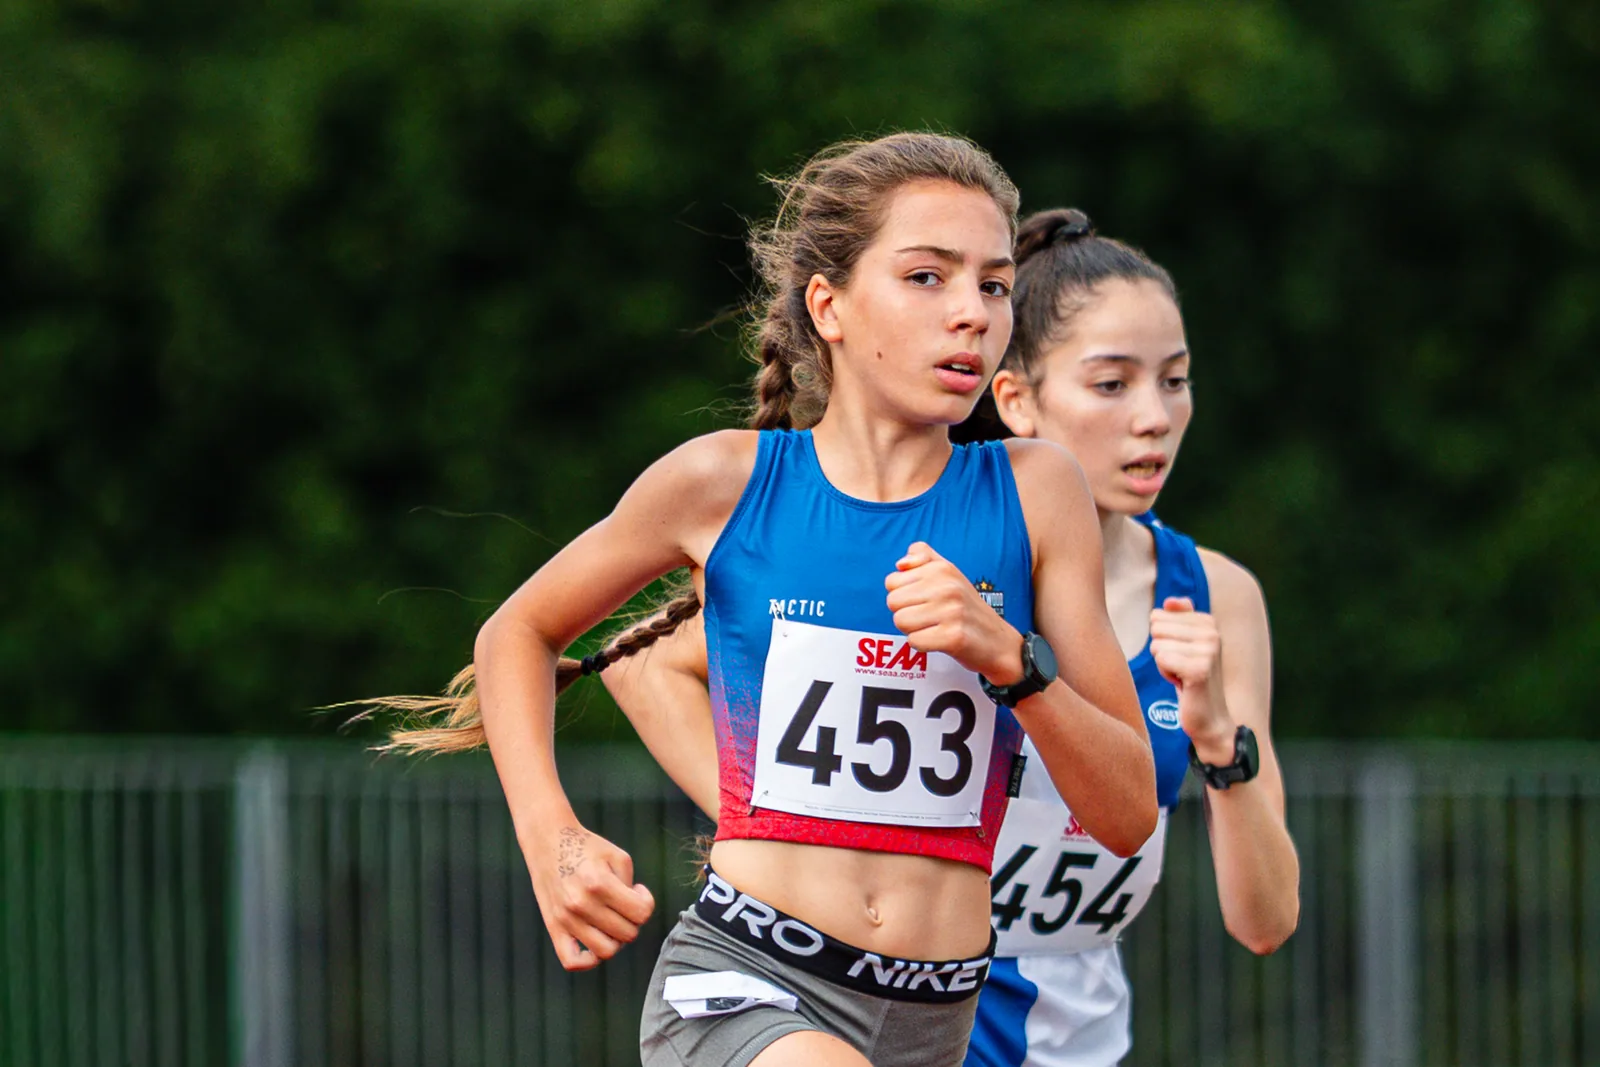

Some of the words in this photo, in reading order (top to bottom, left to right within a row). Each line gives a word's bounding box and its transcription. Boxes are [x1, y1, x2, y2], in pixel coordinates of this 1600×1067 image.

[854, 667, 927, 680] www.seaa.org.uk
[856, 637, 928, 672] SEAA
[774, 680, 977, 797] 453
[700, 873, 825, 957] PRO
[846, 952, 990, 992] NIKE
[990, 844, 1143, 936] 454
